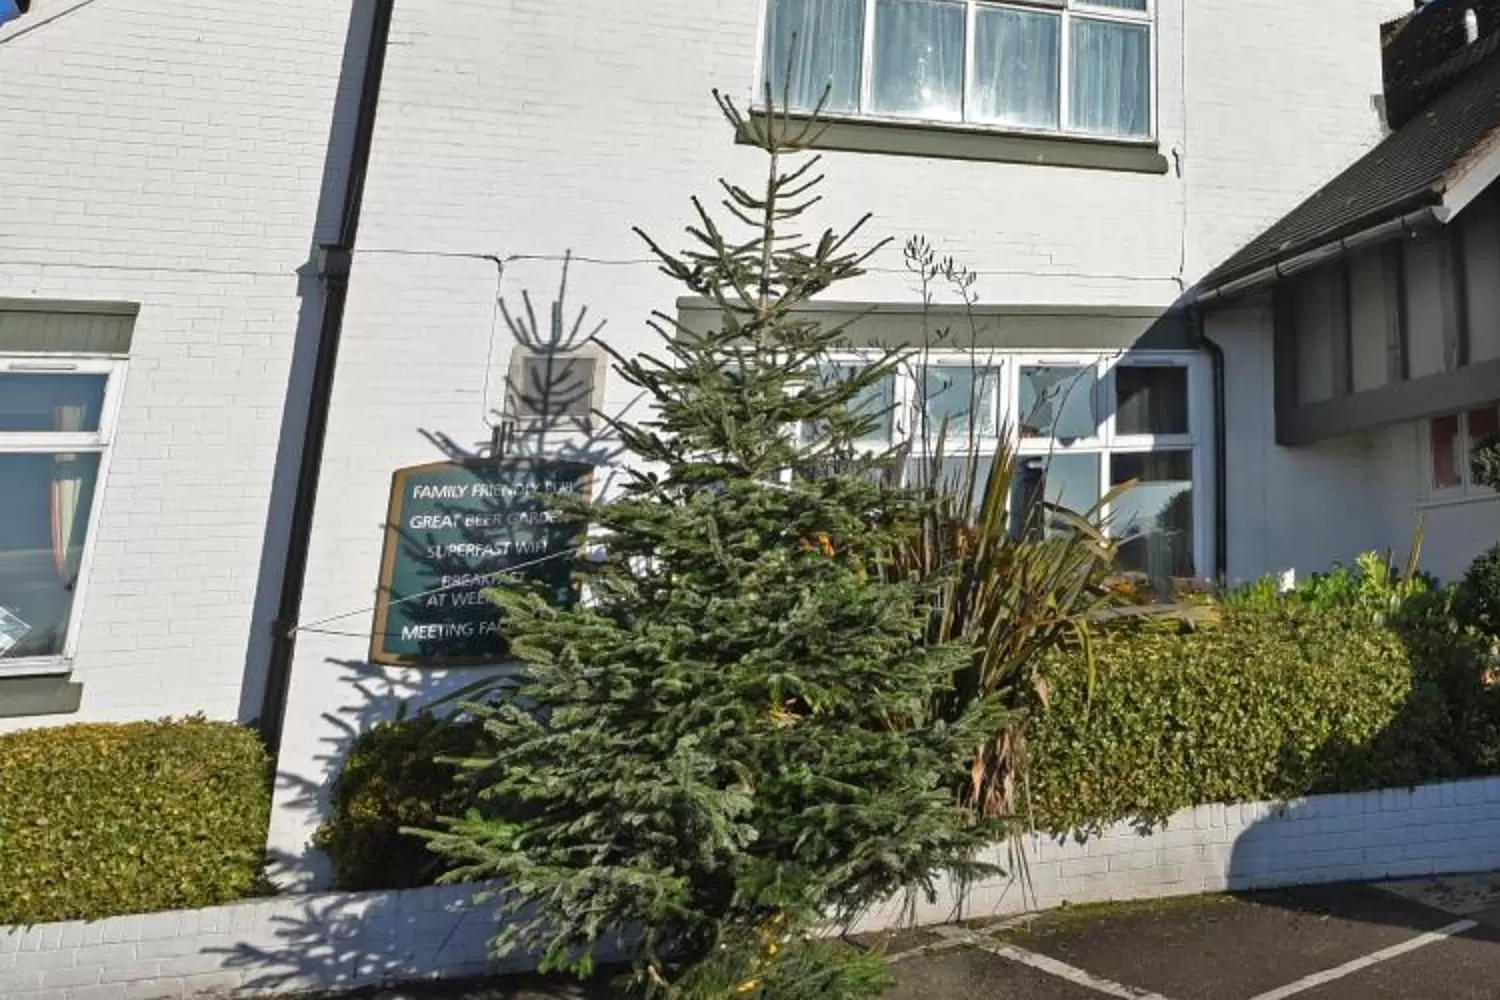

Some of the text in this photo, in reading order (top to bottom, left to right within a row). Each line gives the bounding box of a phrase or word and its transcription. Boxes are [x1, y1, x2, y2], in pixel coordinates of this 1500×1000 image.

[413, 483, 469, 499] FAMILY
[471, 482, 542, 498] FRIENDLY
[409, 513, 461, 529] GREAT
[465, 513, 502, 528] BEER
[427, 540, 512, 560] SUPERFAST
[426, 593, 448, 608] AT
[401, 622, 473, 641] MEETING
